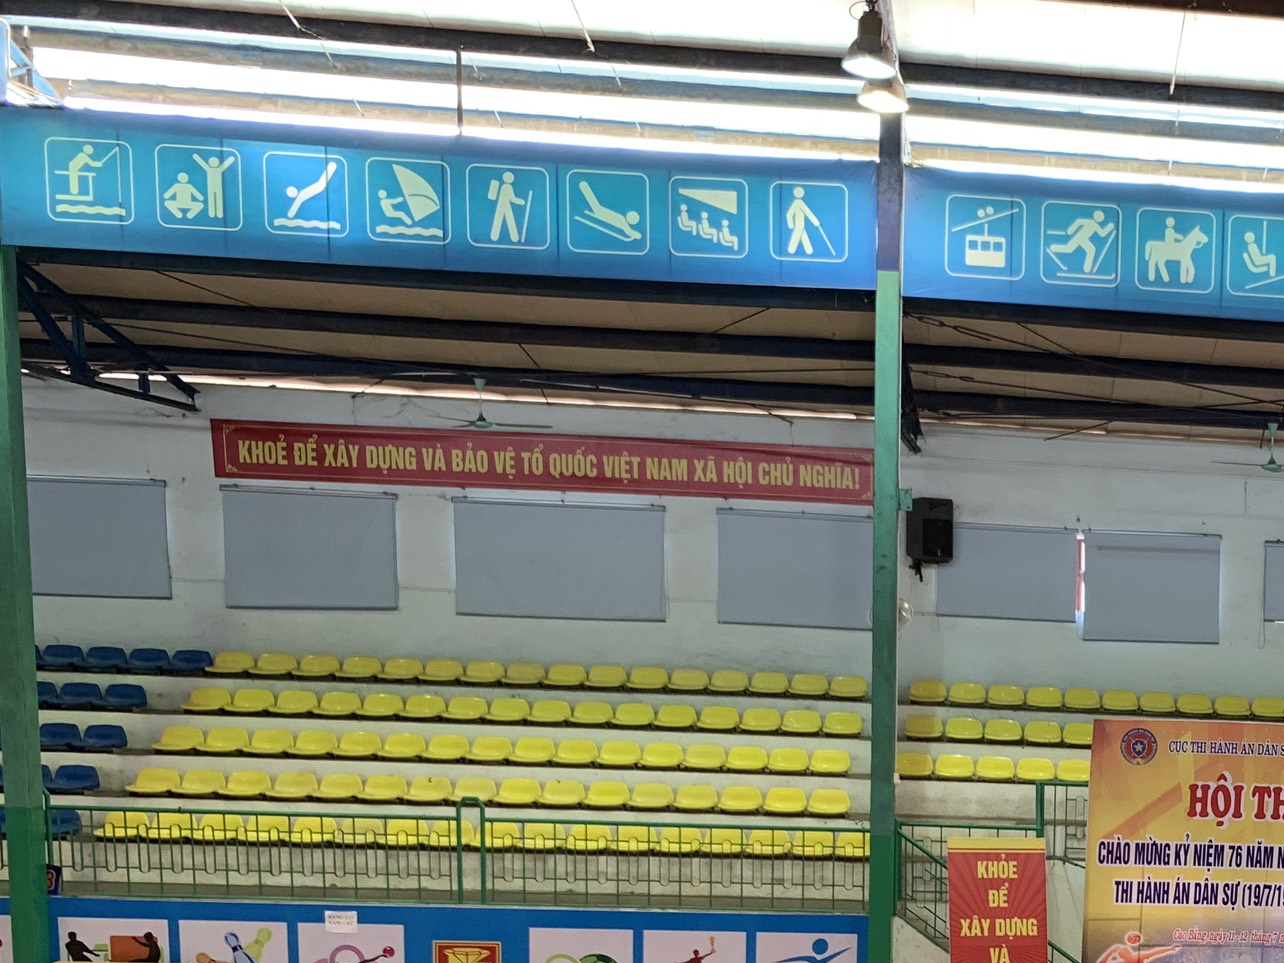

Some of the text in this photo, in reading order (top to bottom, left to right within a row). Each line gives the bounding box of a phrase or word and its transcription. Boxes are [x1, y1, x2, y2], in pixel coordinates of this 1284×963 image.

[238, 434, 860, 490] KHOẺ ĐỂ XÂY DỰNG VÀ BẢO VỆ TỔ QUỐC VIỆT NAM XÃ HỘI CHỦ NGHĨA!
[1168, 740, 1188, 756] CỤC
[1190, 741, 1207, 754] THI
[1209, 738, 1238, 755] HÀNH
[1240, 739, 1255, 755] ÁN
[1257, 739, 1278, 756] DÂN
[1186, 773, 1244, 827] HỘI
[977, 853, 1018, 879] KHỎE
[1098, 836, 1131, 865] CHÀO
[1134, 836, 1171, 866] MỪNG
[1174, 833, 1191, 866] KỶ
[1193, 839, 1225, 872] NIỆM
[1228, 845, 1243, 868] 76
[1245, 841, 1274, 869] NĂM
[988, 882, 1010, 908] ĐỂ
[1114, 880, 1133, 904] THI
[1136, 876, 1170, 904] HÀNH
[1172, 876, 1190, 905] ÁN
[1193, 877, 1219, 906] DÂN
[1221, 881, 1241, 911] SỰ
[960, 915, 1038, 940] XÂY DỰNG
